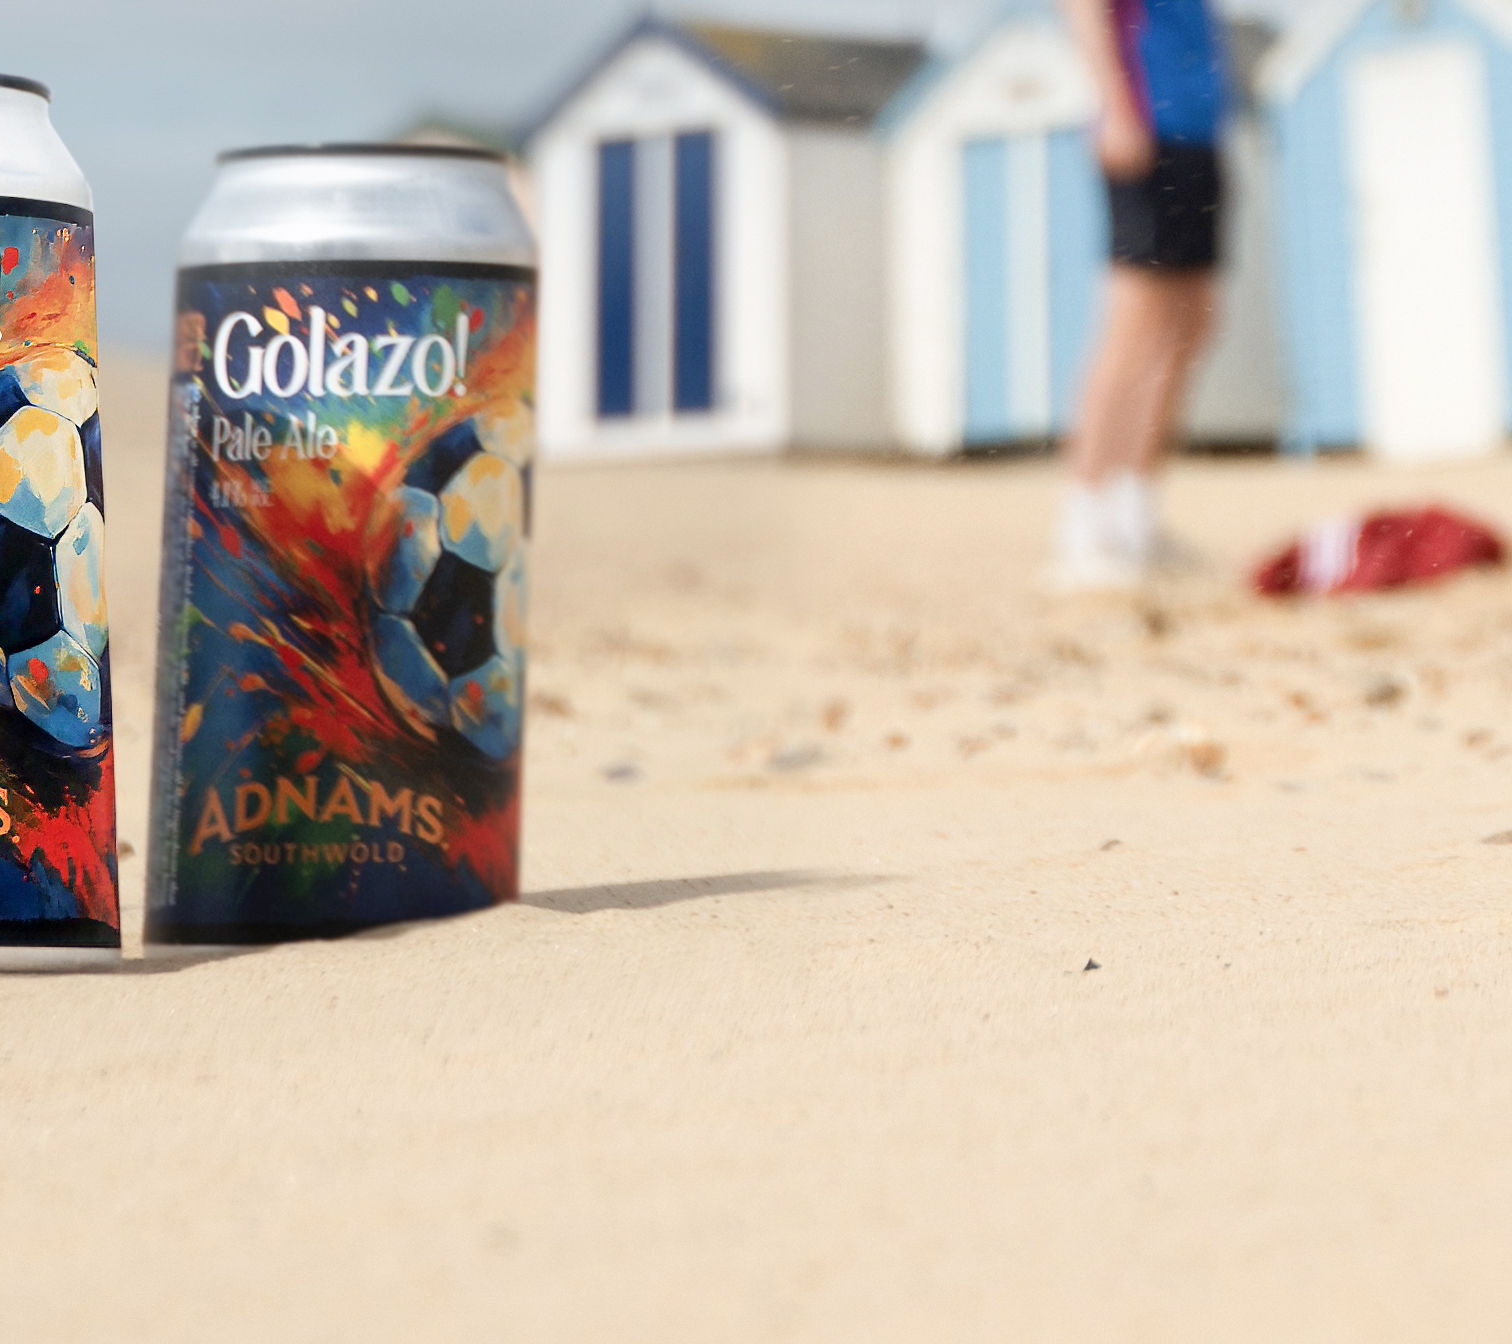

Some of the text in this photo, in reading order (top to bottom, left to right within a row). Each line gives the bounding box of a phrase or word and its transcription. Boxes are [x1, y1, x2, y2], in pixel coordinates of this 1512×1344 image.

[213, 305, 469, 400] Golazo!
[212, 409, 339, 462] Pale Ale
[188, 774, 444, 857] ADNAMS
[228, 841, 406, 866] SOUTHWOLD
